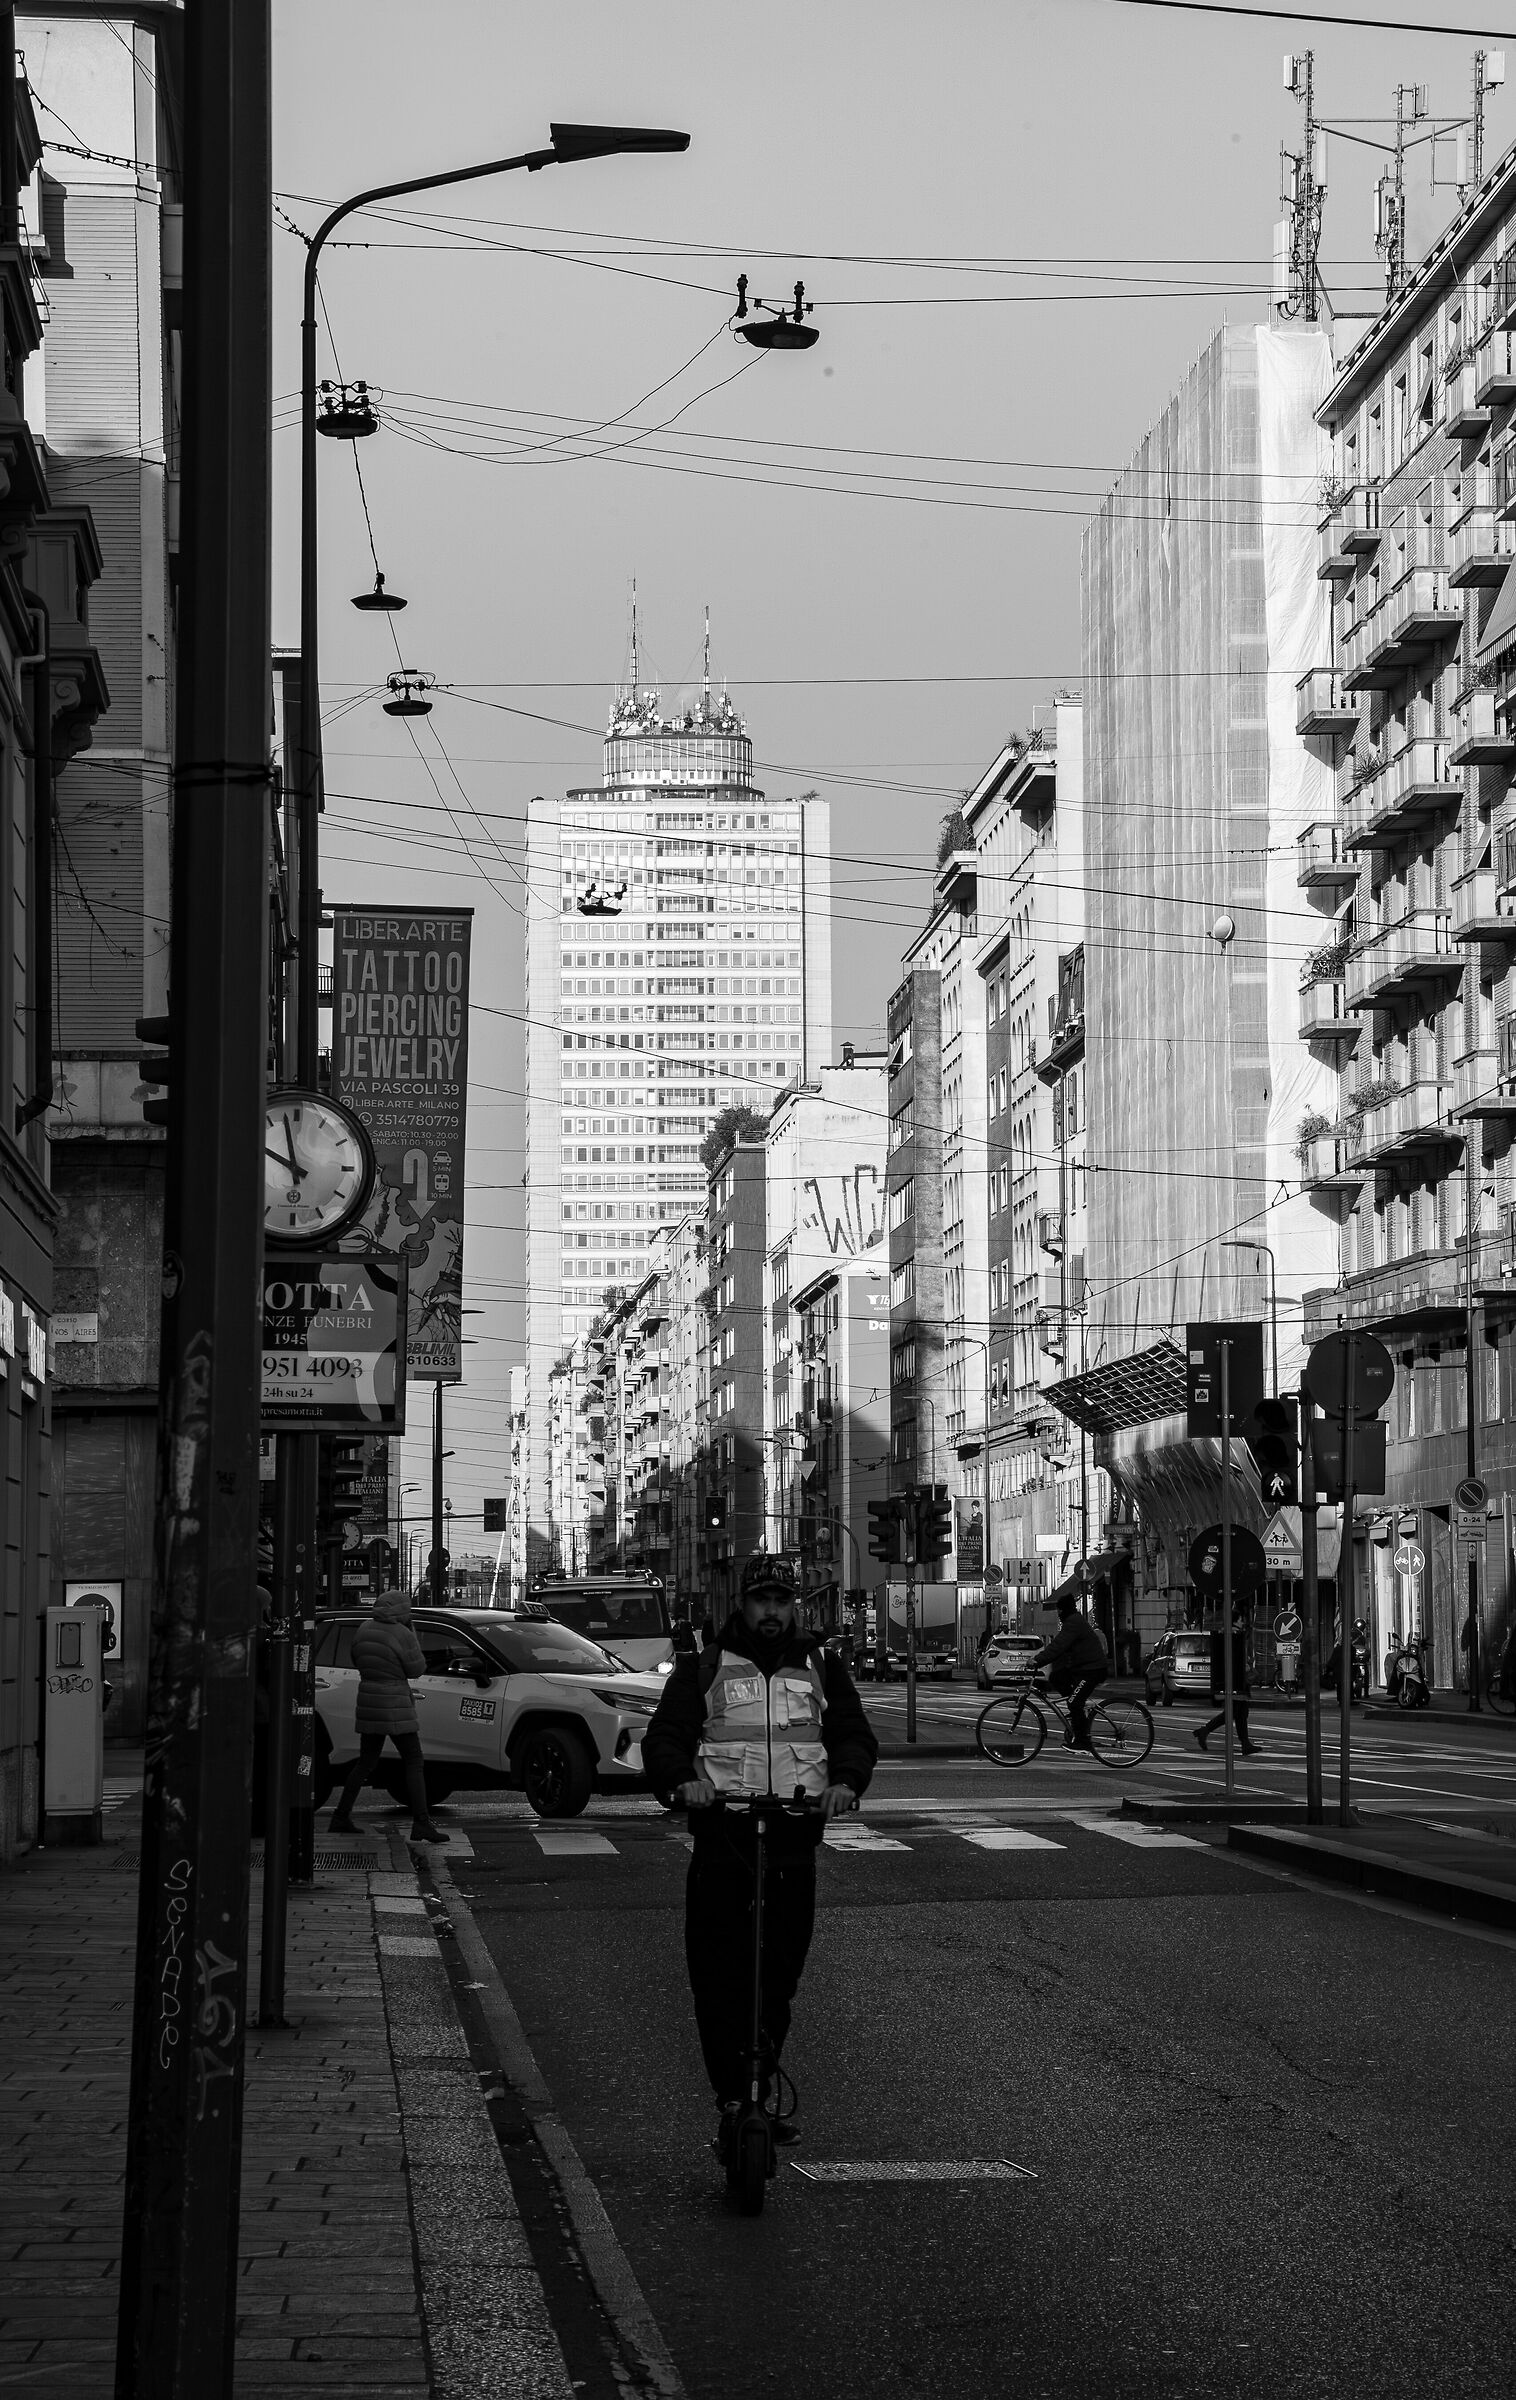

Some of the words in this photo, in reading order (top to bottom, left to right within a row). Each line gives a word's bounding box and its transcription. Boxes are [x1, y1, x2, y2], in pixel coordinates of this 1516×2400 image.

[342, 919, 463, 942] LIBER.ARTE
[342, 949, 463, 994] TATTOO
[340, 992, 462, 1037] PIERCING
[339, 1036, 460, 1080] JEWELRY
[340, 1081, 367, 1093] VIA
[372, 1082, 437, 1095] PASCOLI
[442, 1084, 460, 1095] 39
[355, 1099, 460, 1110] LIBER.ARTE_MILANO
[376, 1114, 459, 1127] 3514780779
[265, 1282, 374, 1311] OTTA
[264, 1315, 296, 1328] NZE
[304, 1316, 372, 1328] FUNEBRI
[75, 1328, 97, 1336] AIRES
[274, 1333, 307, 1345] 1945
[407, 1355, 456, 1366] 610633
[262, 1356, 299, 1378] 951
[306, 1357, 363, 1379] 4093
[263, 1387, 283, 1398] 24h
[286, 1389, 298, 1398] su
[300, 1387, 314, 1398] 24
[461, 1705, 482, 1717] 8585
